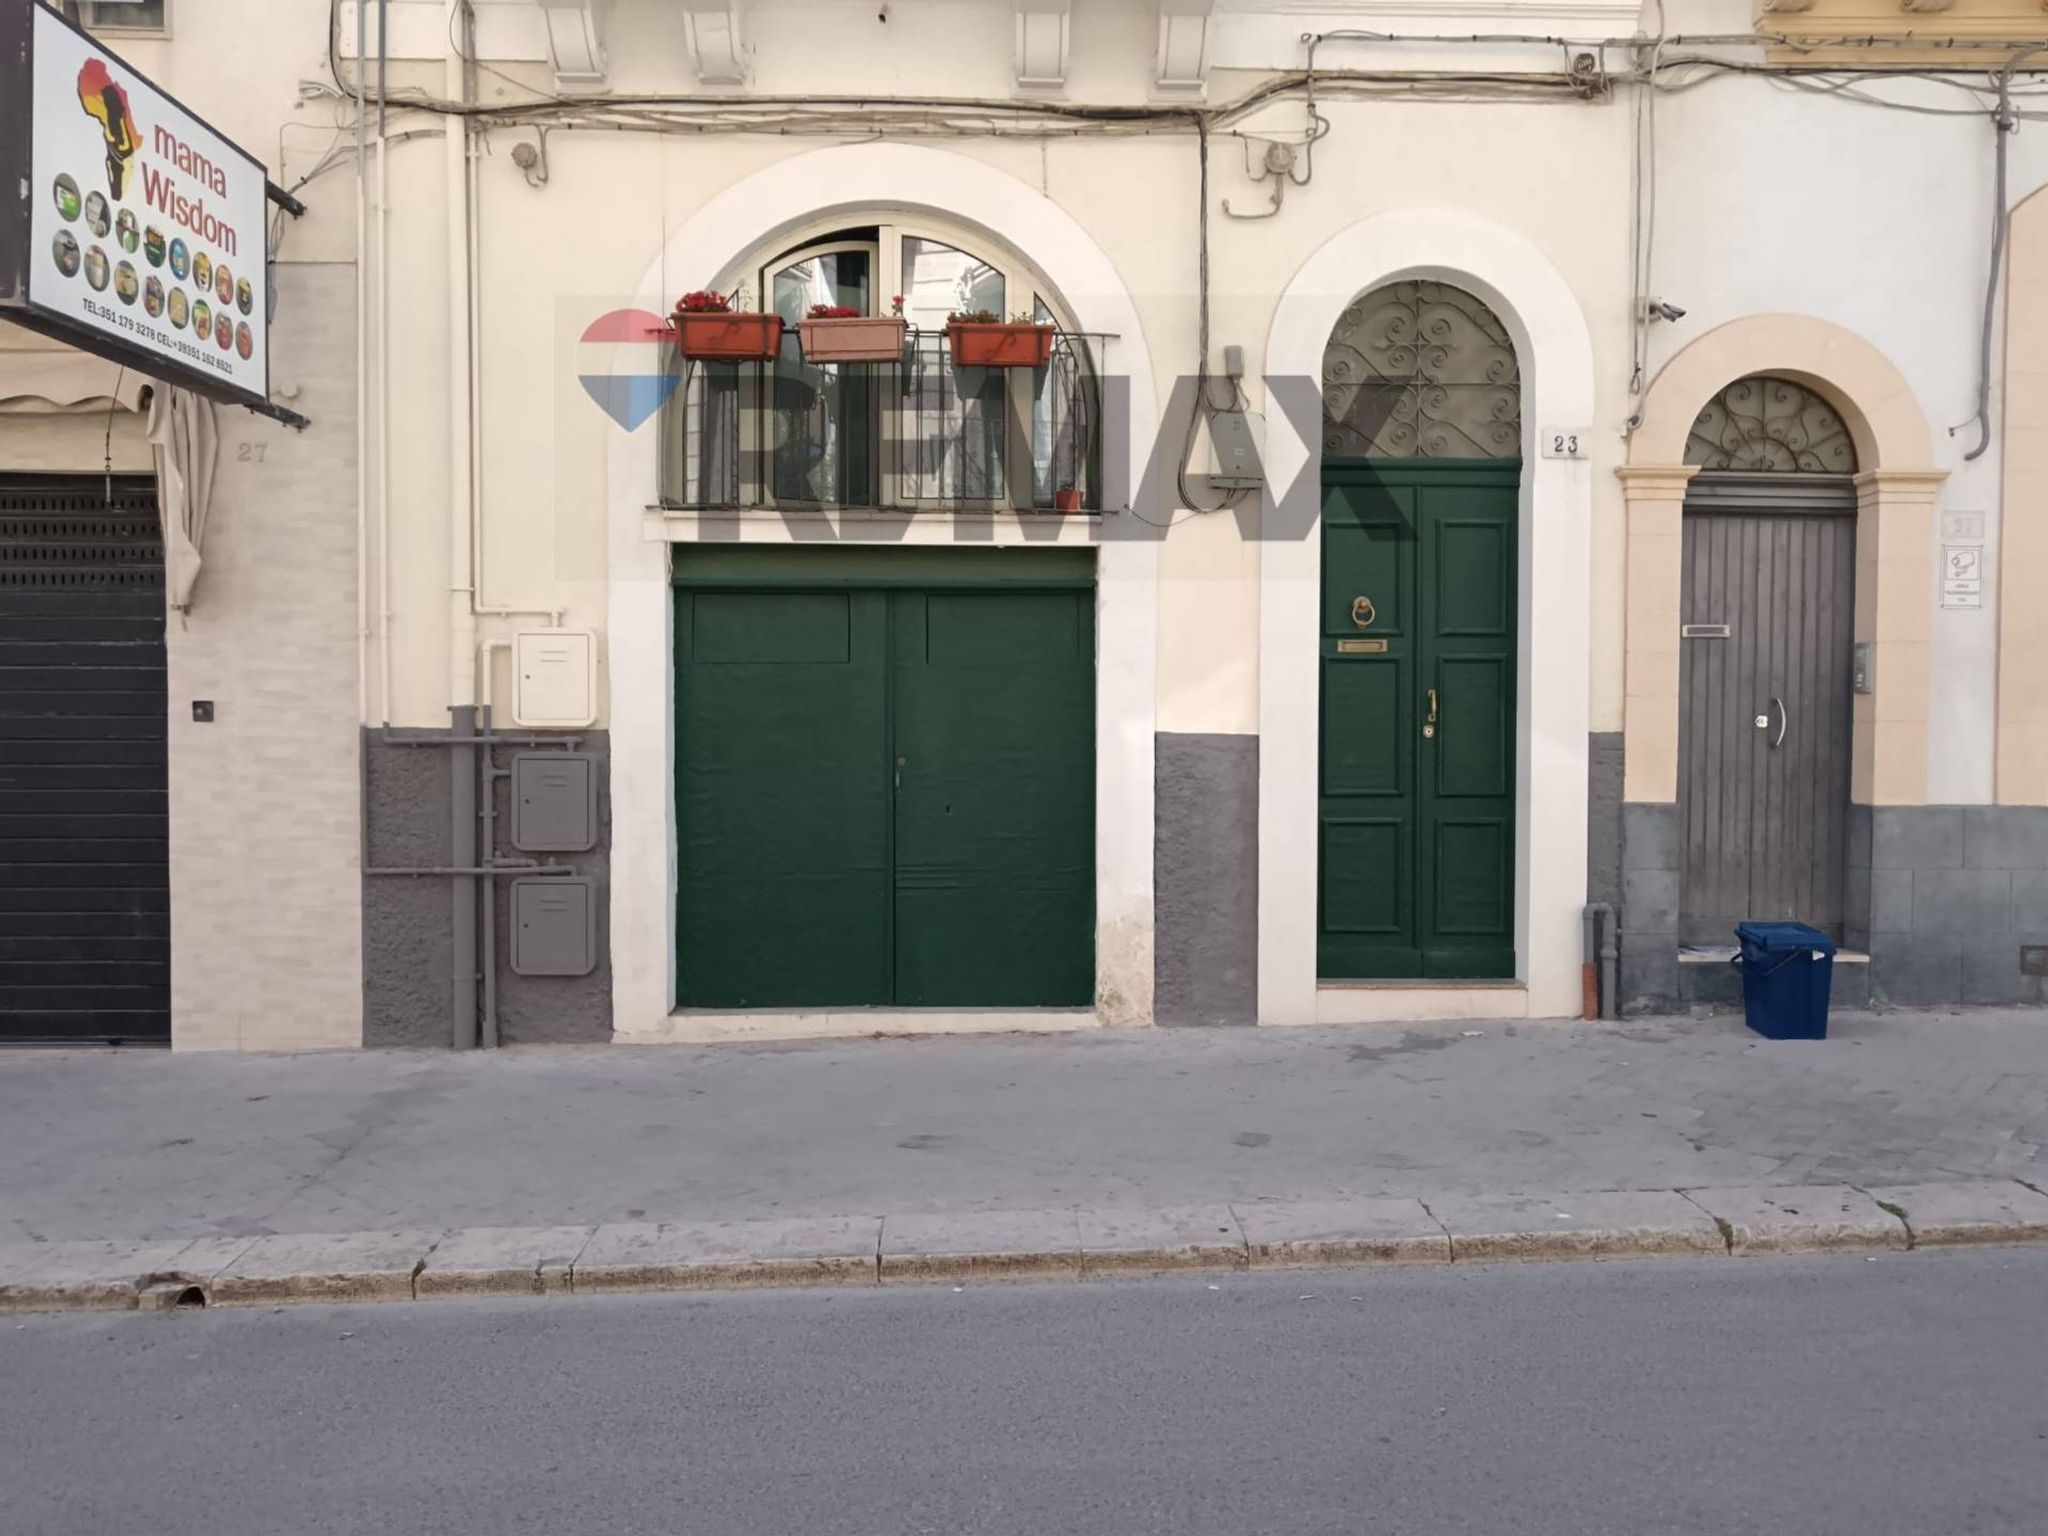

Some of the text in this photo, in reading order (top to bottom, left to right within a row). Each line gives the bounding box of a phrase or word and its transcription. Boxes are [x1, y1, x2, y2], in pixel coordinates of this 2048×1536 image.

[154, 123, 227, 199] mama
[141, 160, 237, 257] Wisdom
[118, 314, 134, 331] 179
[135, 322, 155, 341] 3278
[237, 441, 268, 463] 27
[1553, 435, 1578, 453] 23
